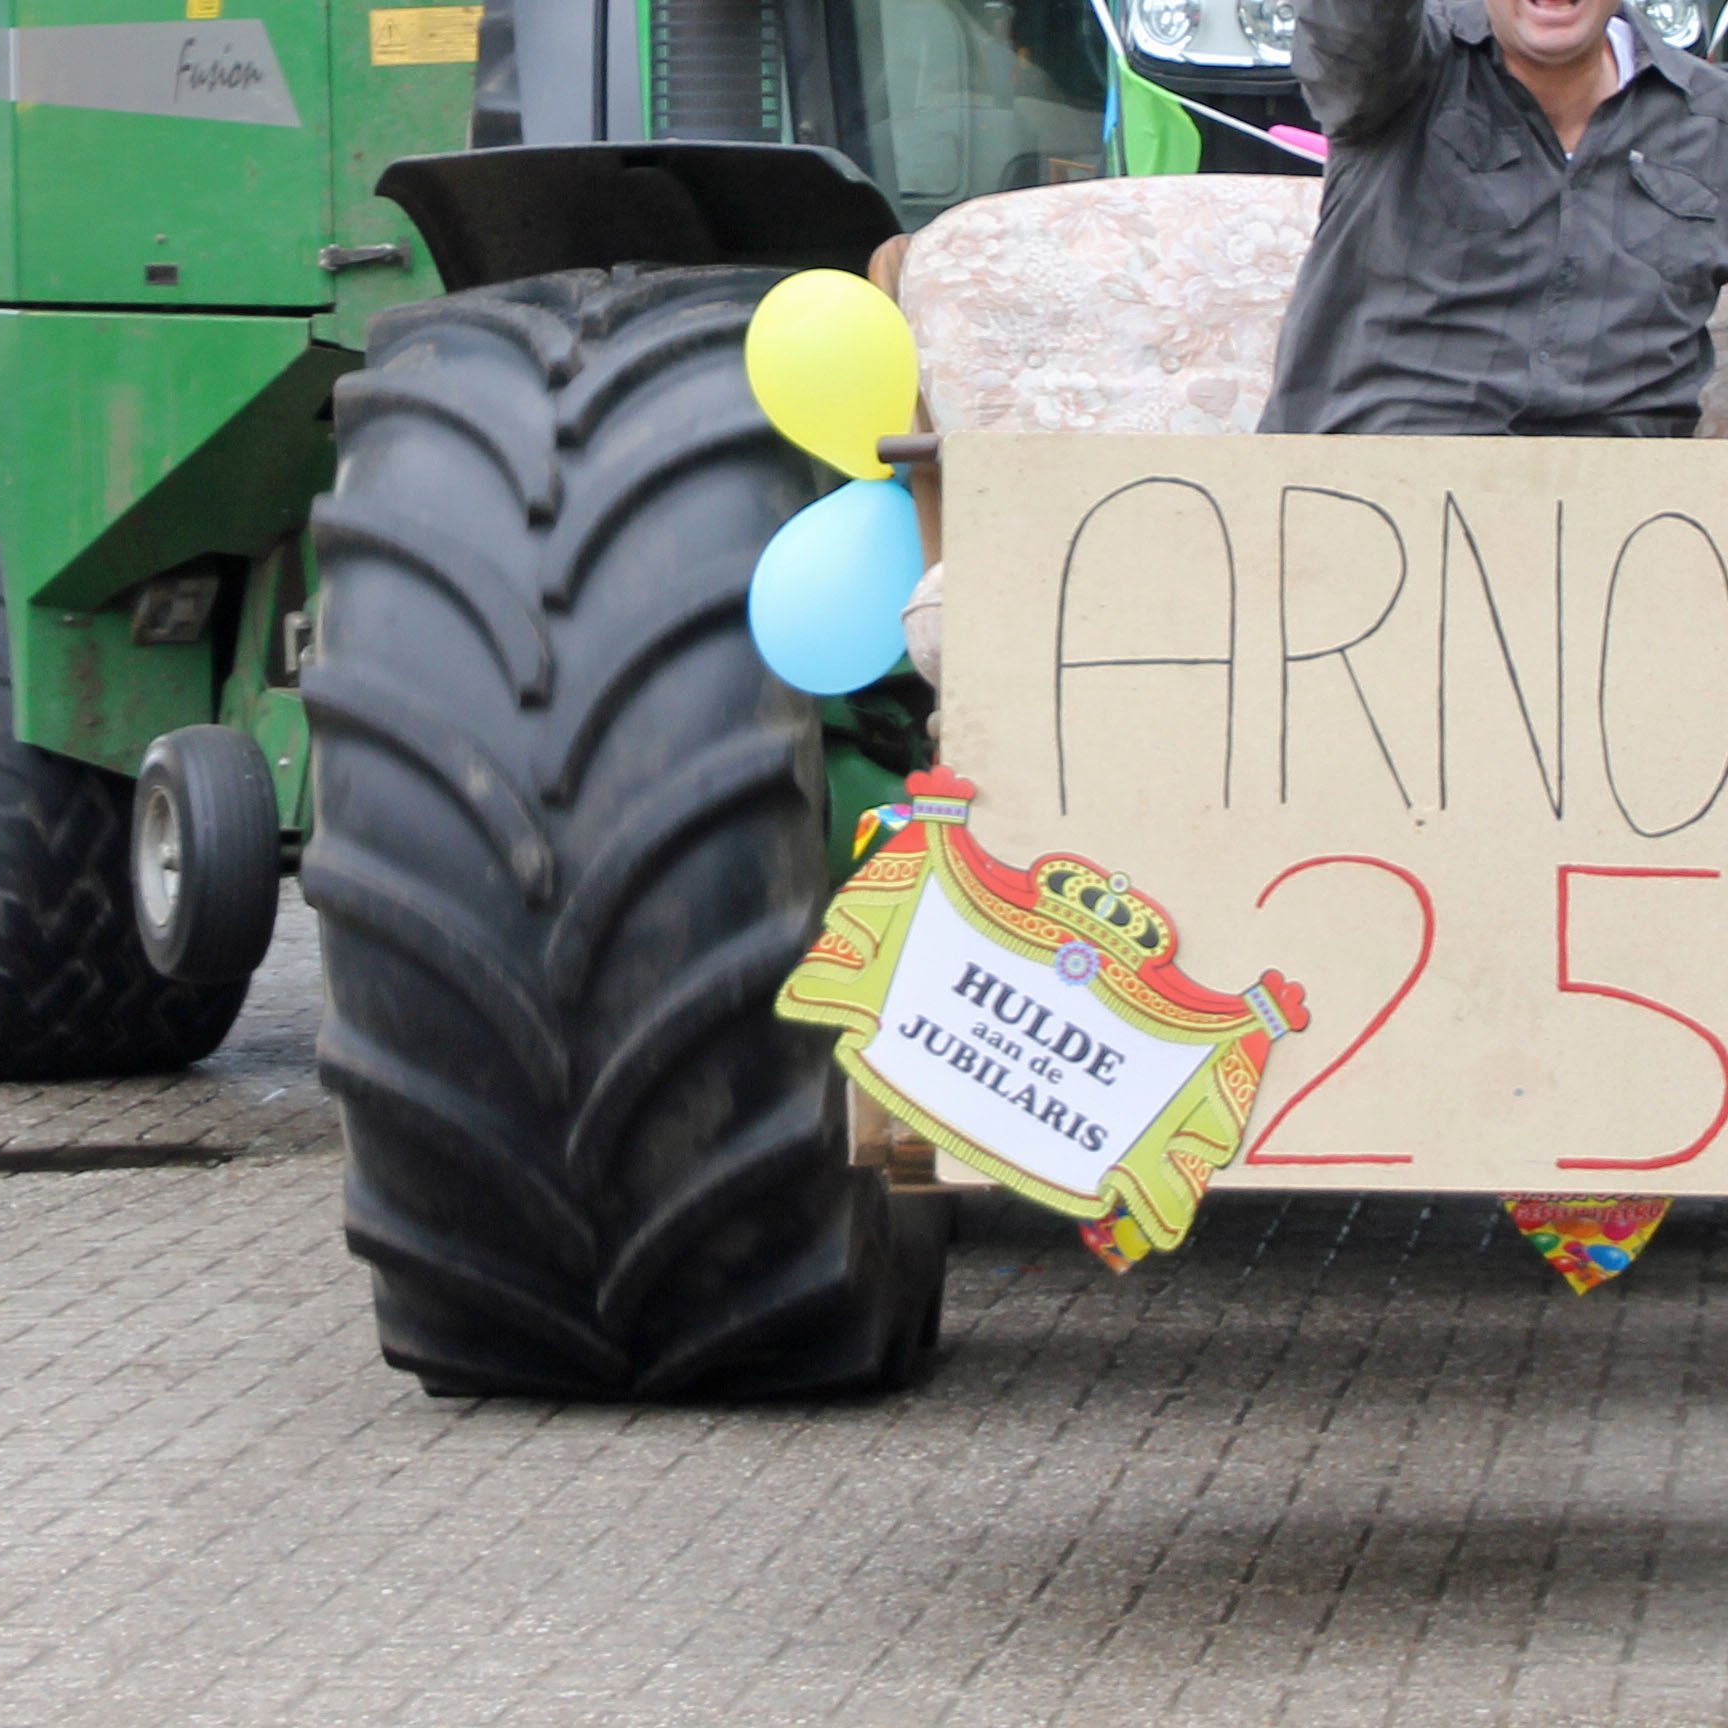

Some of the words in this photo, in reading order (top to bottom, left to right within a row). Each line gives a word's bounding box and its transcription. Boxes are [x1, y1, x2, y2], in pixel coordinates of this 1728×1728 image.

[174, 37, 262, 103] Fusion
[951, 961, 1126, 1087] HULDE
[970, 1021, 1024, 1061] aan
[1028, 1055, 1064, 1085] de
[898, 1014, 1109, 1152] JUBILARIS
